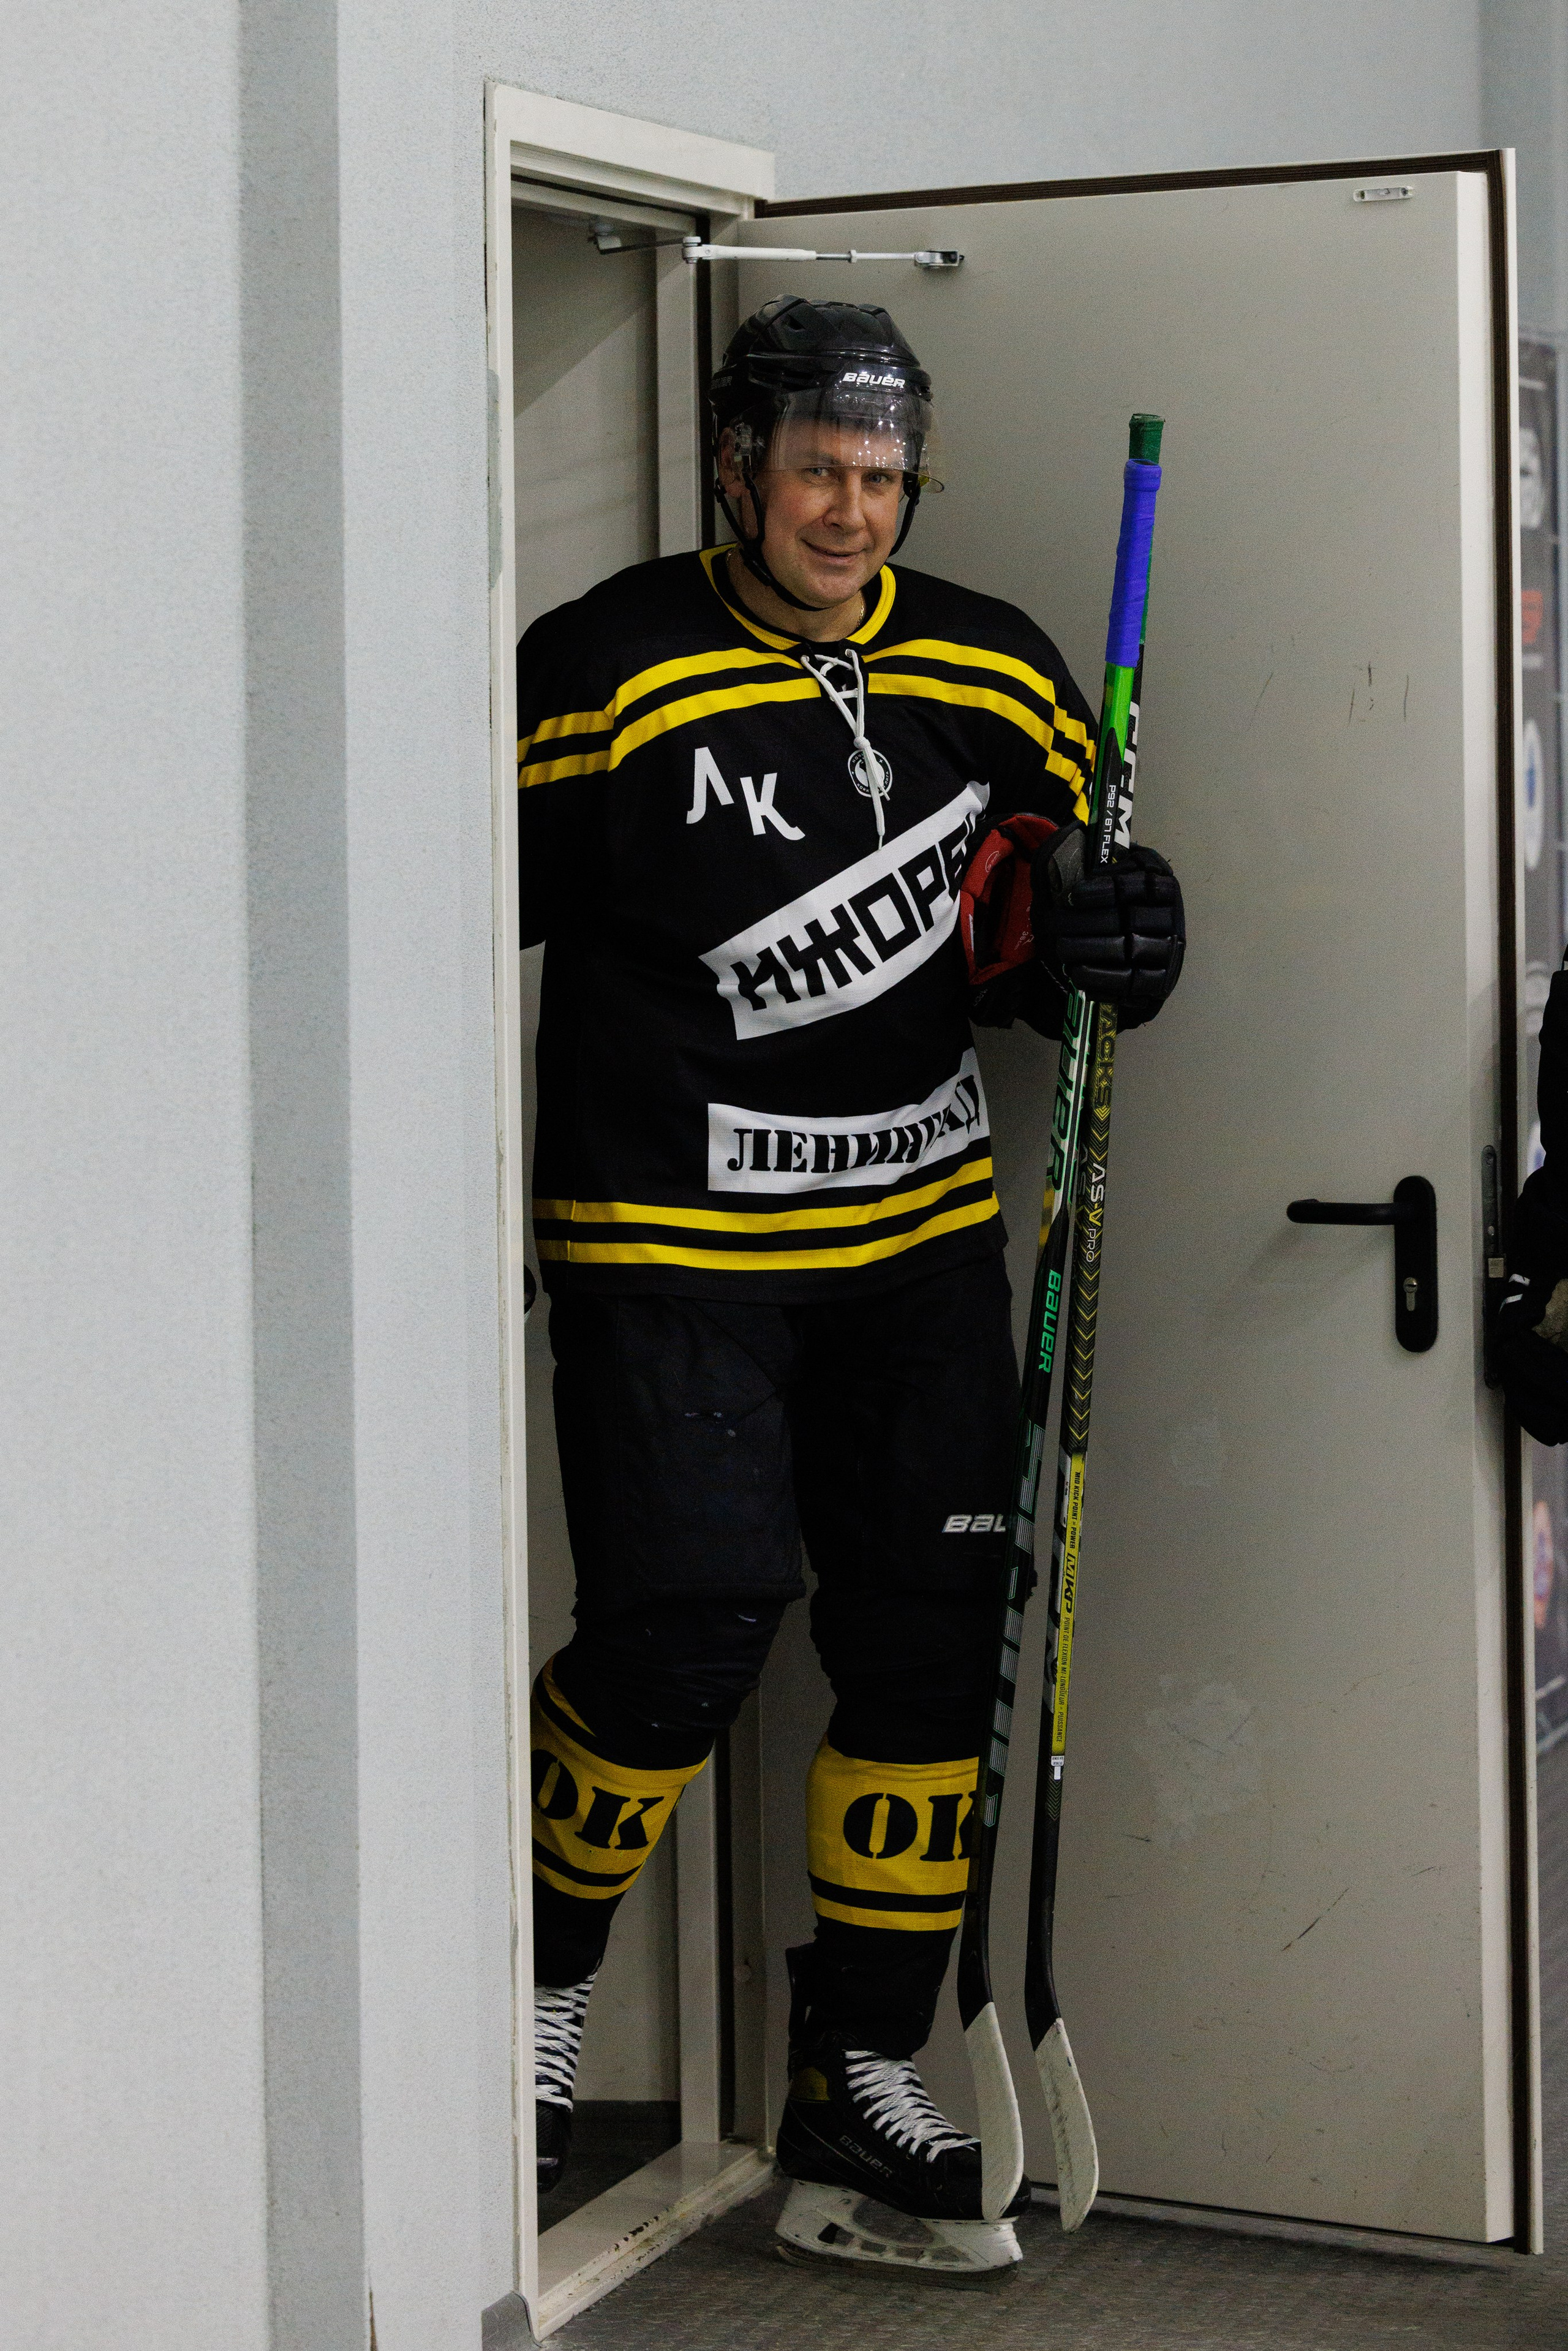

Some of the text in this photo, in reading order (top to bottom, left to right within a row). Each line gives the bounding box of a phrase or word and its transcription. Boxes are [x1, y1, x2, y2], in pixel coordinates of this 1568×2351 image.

[1104, 818, 1112, 832] 87
[1107, 784, 1117, 807] P92
[1114, 701, 1140, 849] CCM
[1100, 834, 1110, 864] FLEX
[730, 813, 973, 1011] ИЖОРЕ
[1046, 982, 1083, 1193] AUER
[1094, 1003, 1117, 1109] ACKS
[1086, 1162, 1106, 1262] AS-V PRO
[1056, 1711, 1065, 1743] PUISSANCE
